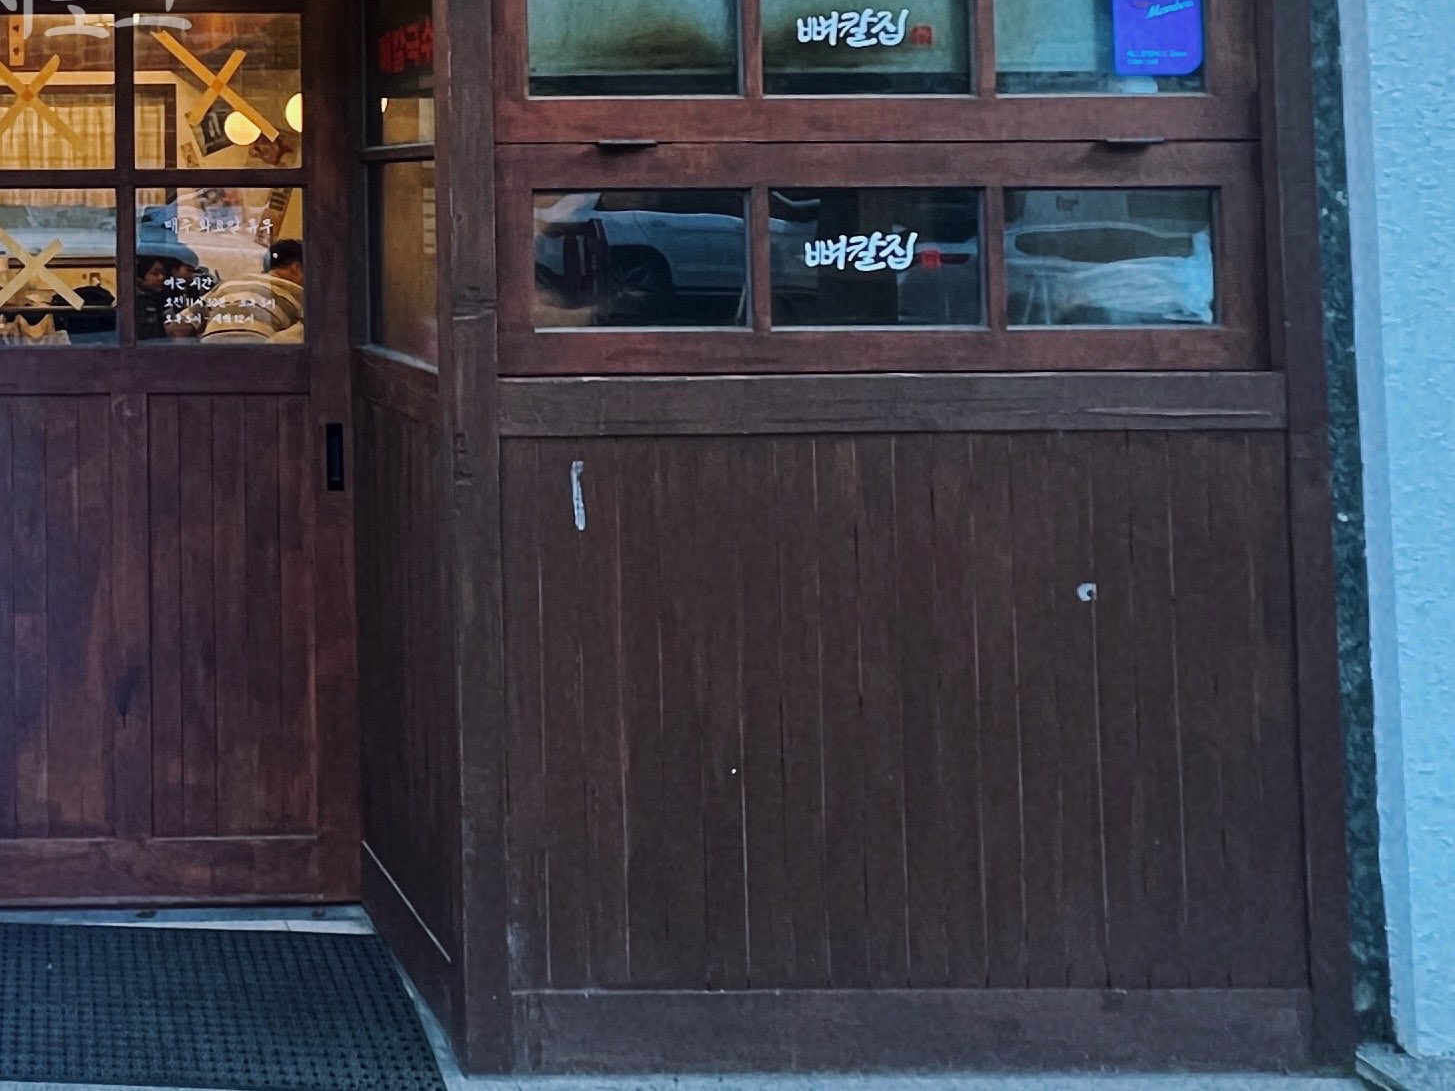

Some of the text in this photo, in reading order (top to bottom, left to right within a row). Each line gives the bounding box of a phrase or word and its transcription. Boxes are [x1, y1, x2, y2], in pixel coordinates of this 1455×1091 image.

[796, 8, 910, 47] 뼈칼집
[804, 231, 918, 272] 뼈칼집
[190, 276, 213, 290] 시간
